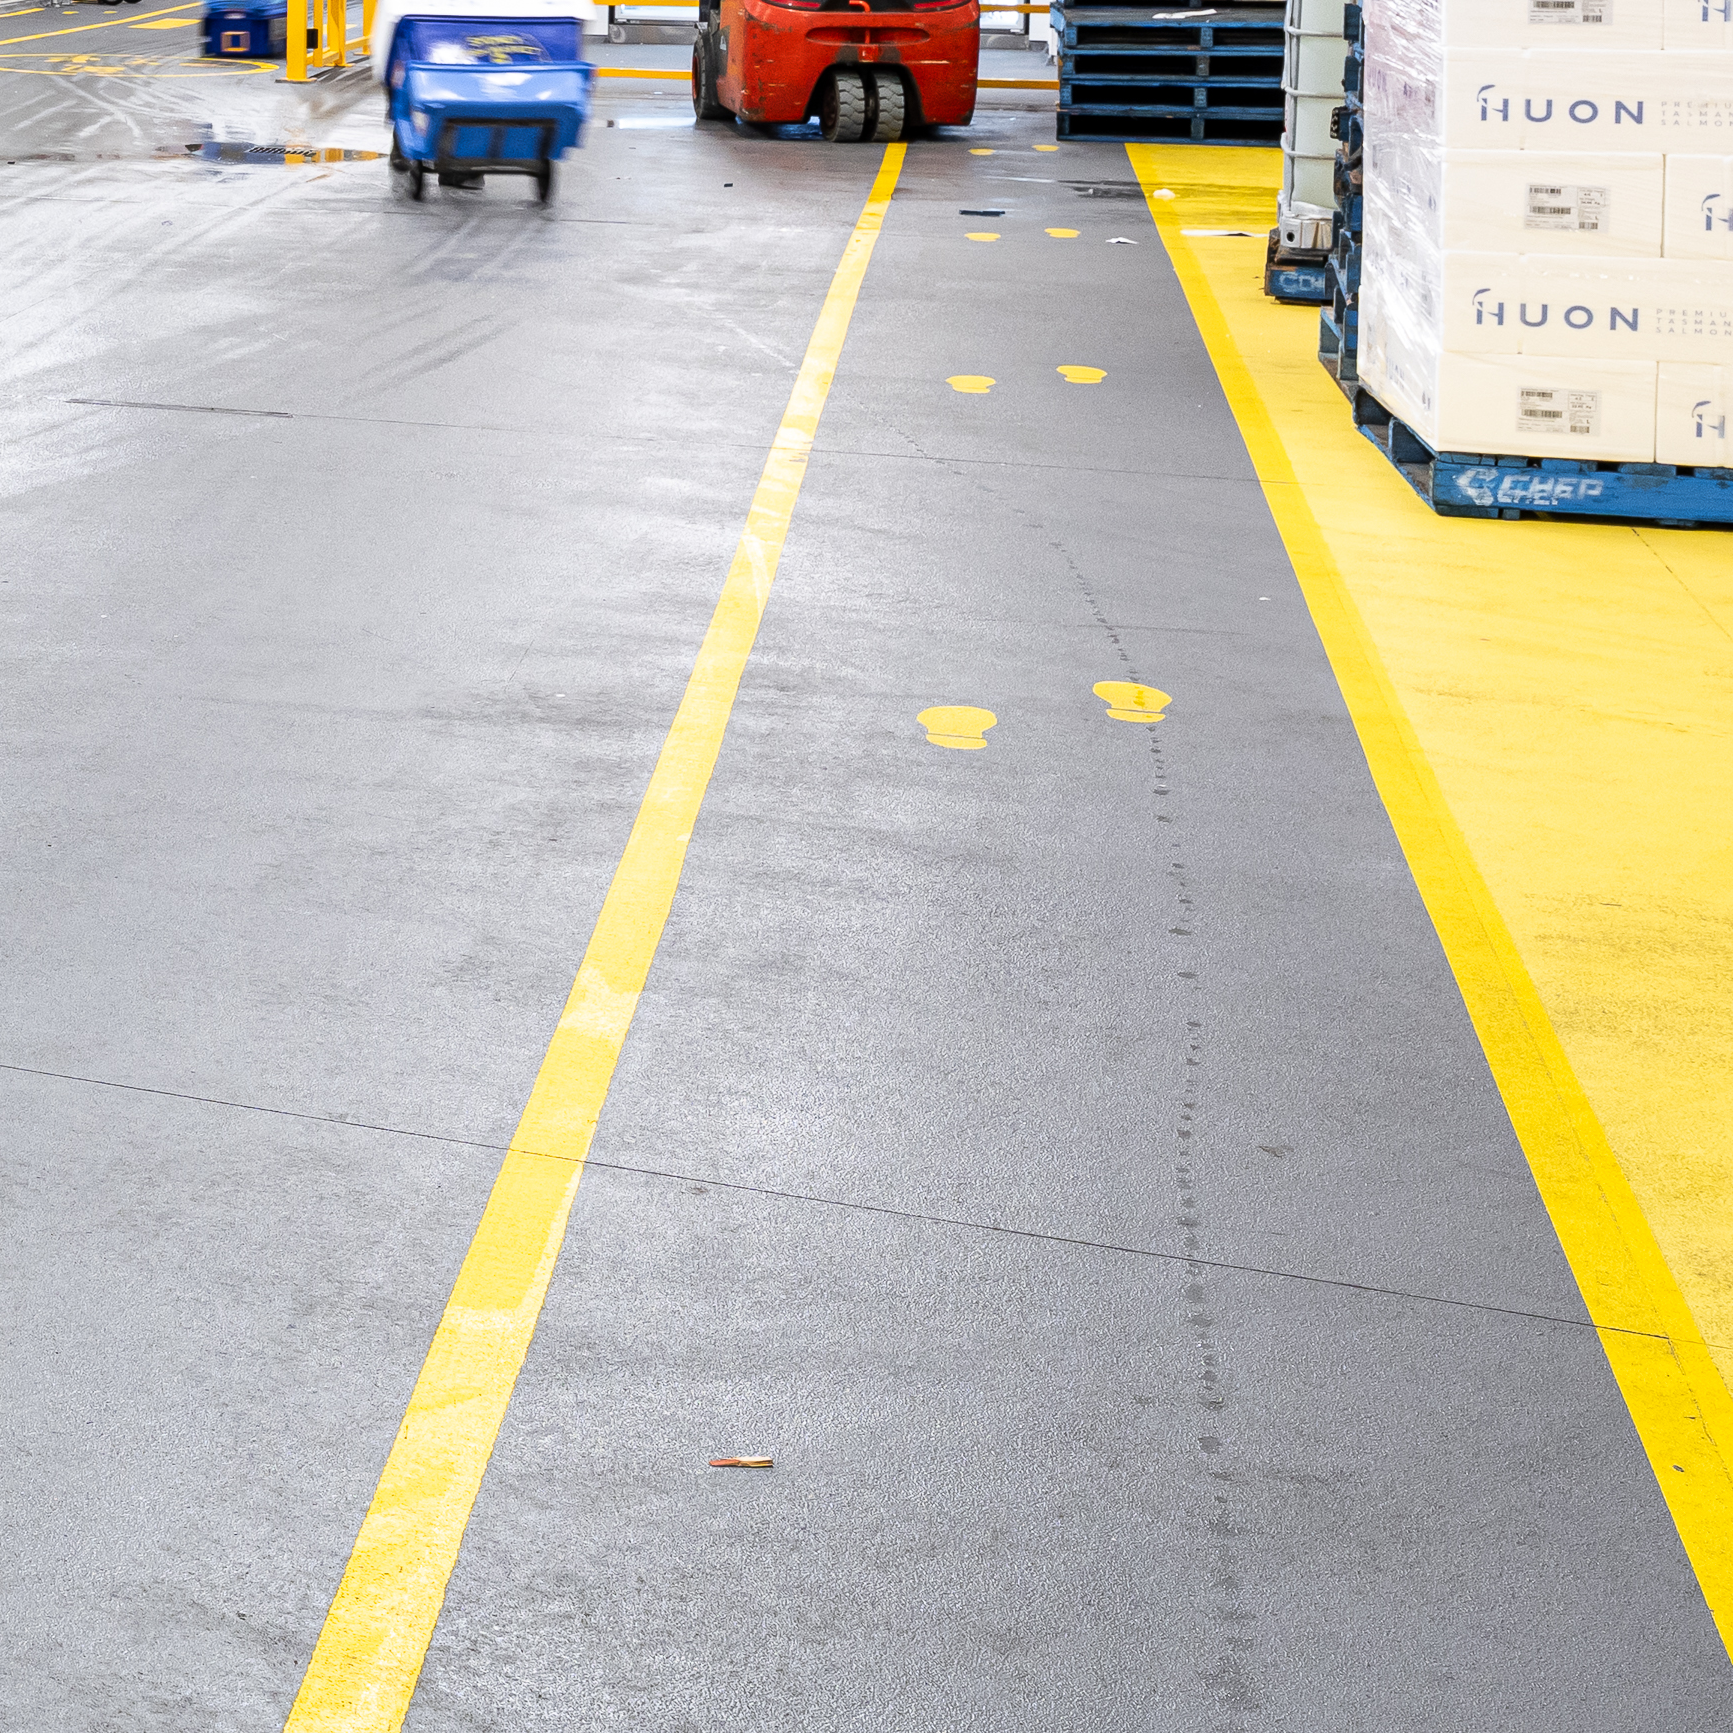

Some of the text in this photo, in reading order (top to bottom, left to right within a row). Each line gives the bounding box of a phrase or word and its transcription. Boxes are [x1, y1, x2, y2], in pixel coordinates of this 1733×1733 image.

[1477, 84, 1644, 124] HUON
[1661, 101, 1733, 109] PREMIU
[1472, 288, 1639, 331] HUON
[1656, 308, 1727, 318] PREMIU
[1656, 327, 1732, 336] SALMON
